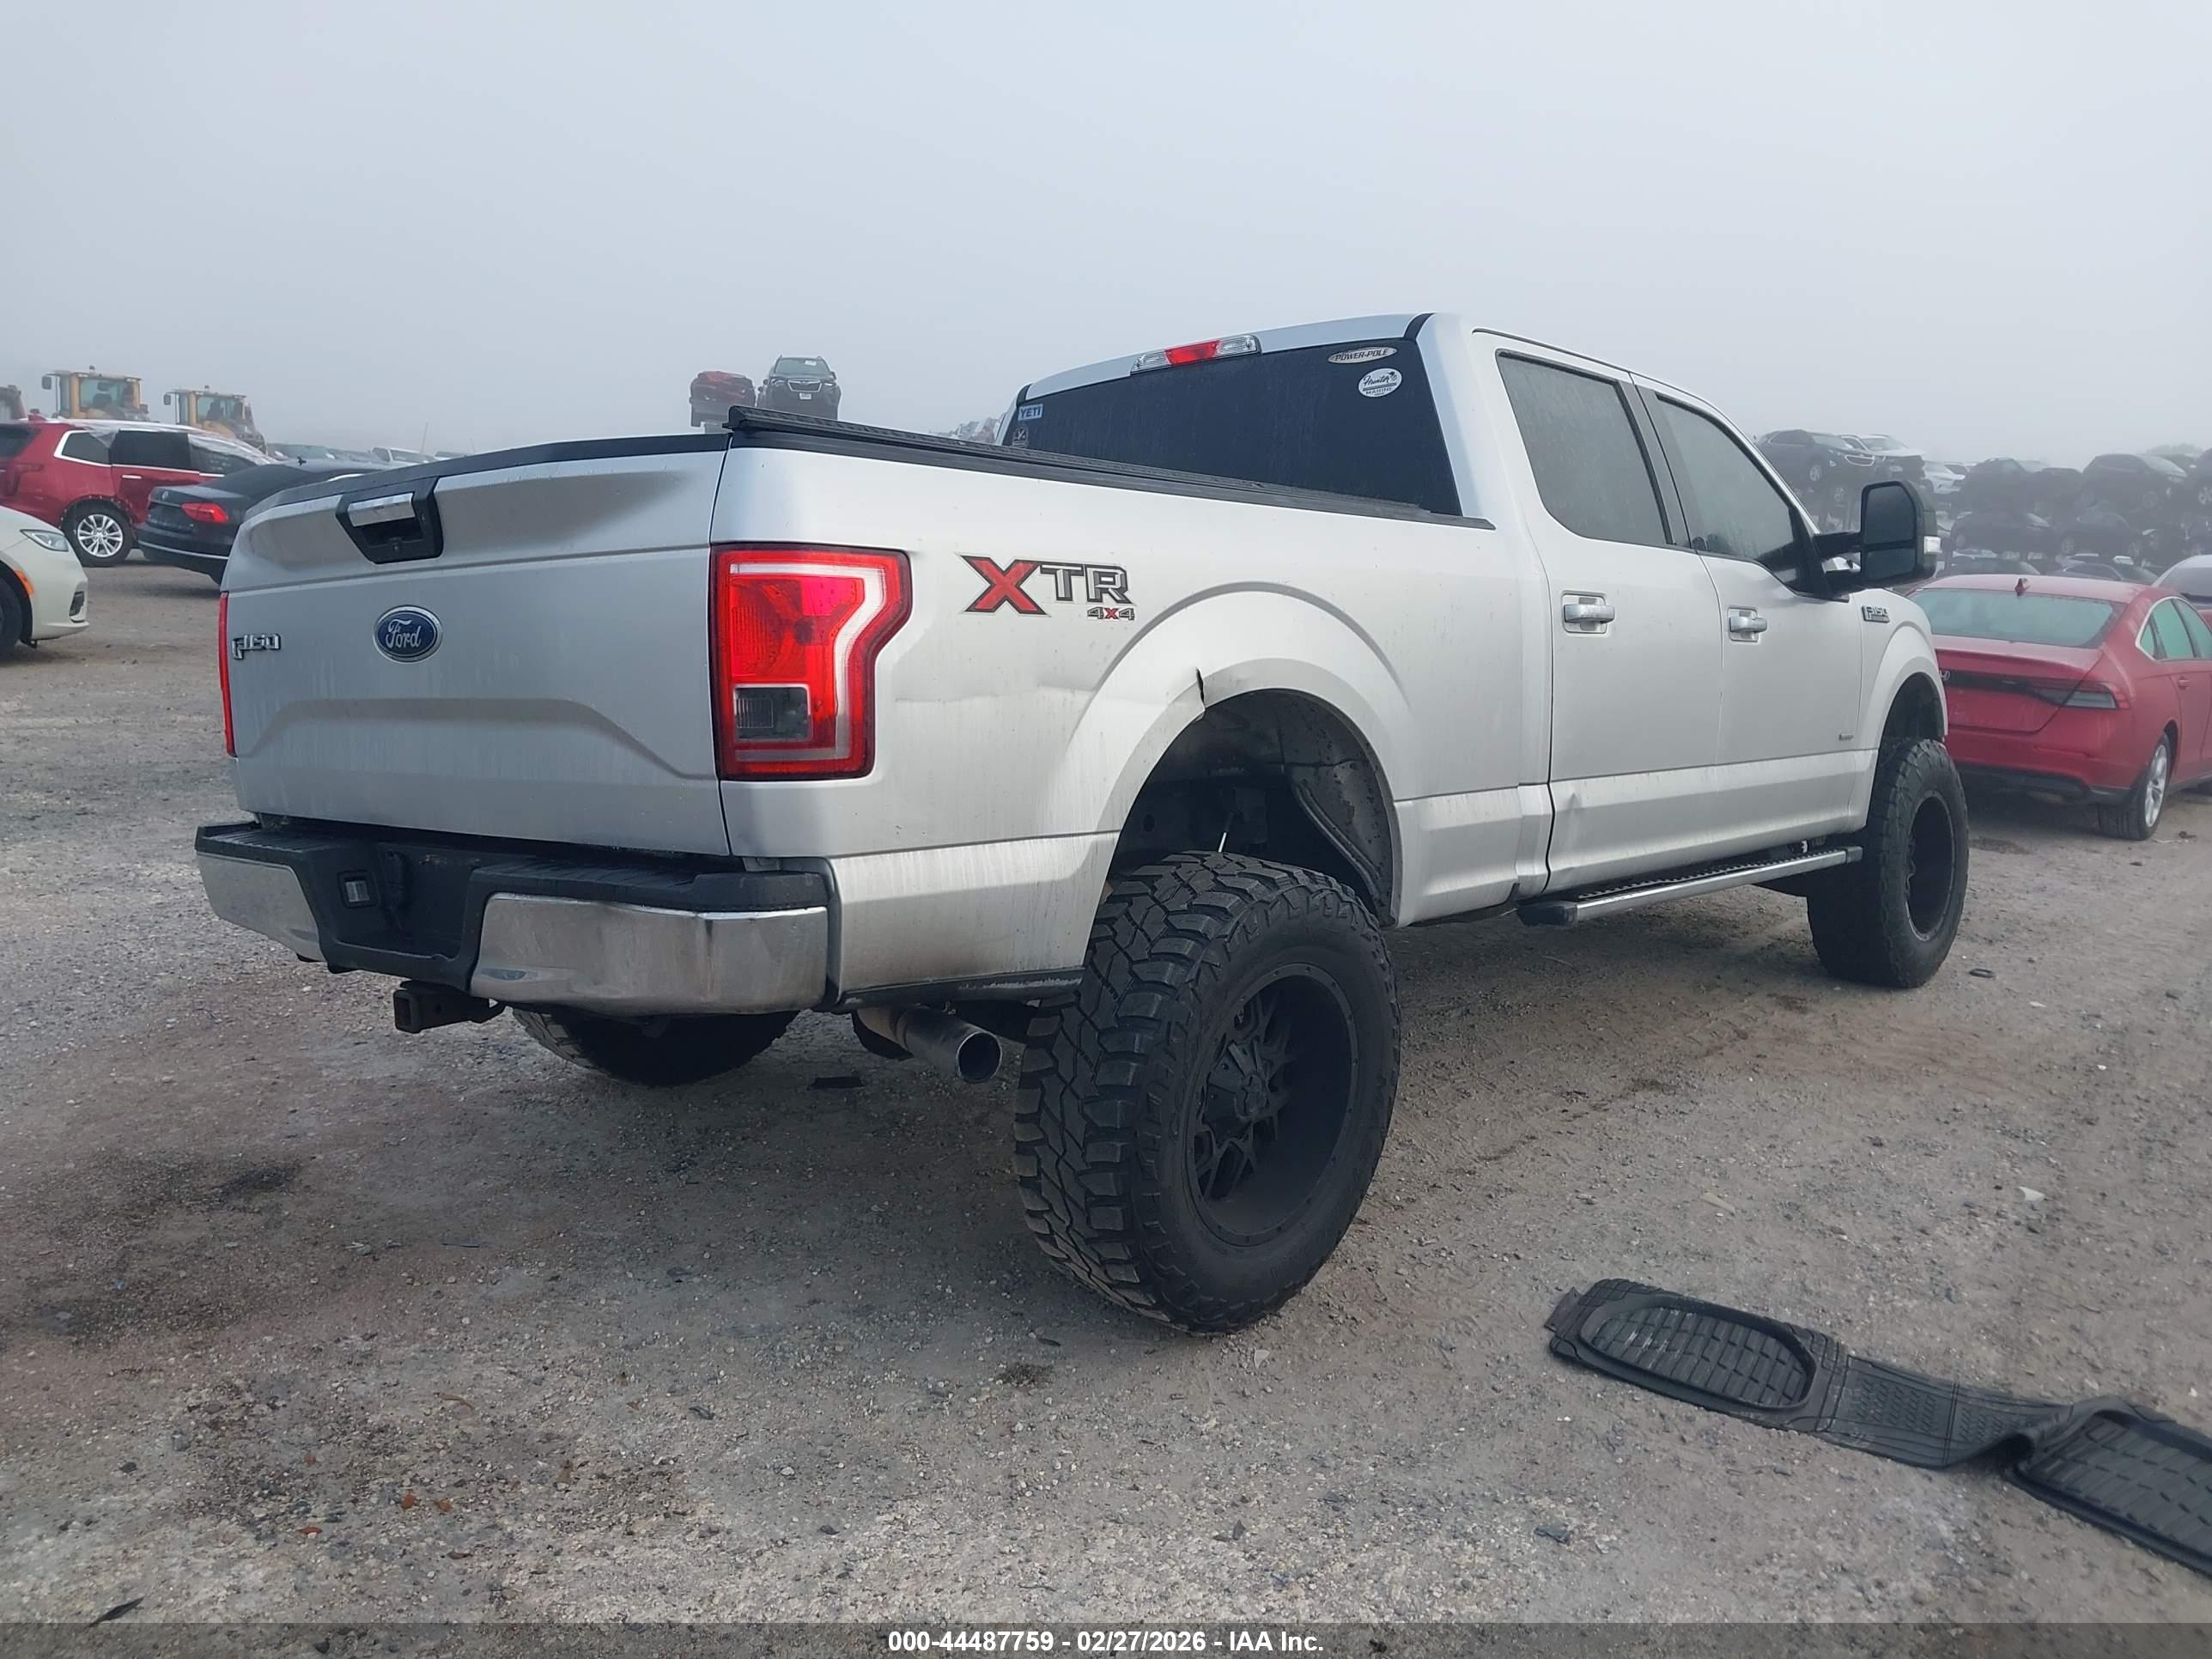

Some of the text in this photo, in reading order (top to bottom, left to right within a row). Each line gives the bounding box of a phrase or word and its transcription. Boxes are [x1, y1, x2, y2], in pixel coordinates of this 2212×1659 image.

[1334, 349, 1389, 362] POWER-POLE
[1020, 407, 1042, 418] YETI
[960, 555, 1133, 615] XTR
[386, 618, 422, 649] Ford
